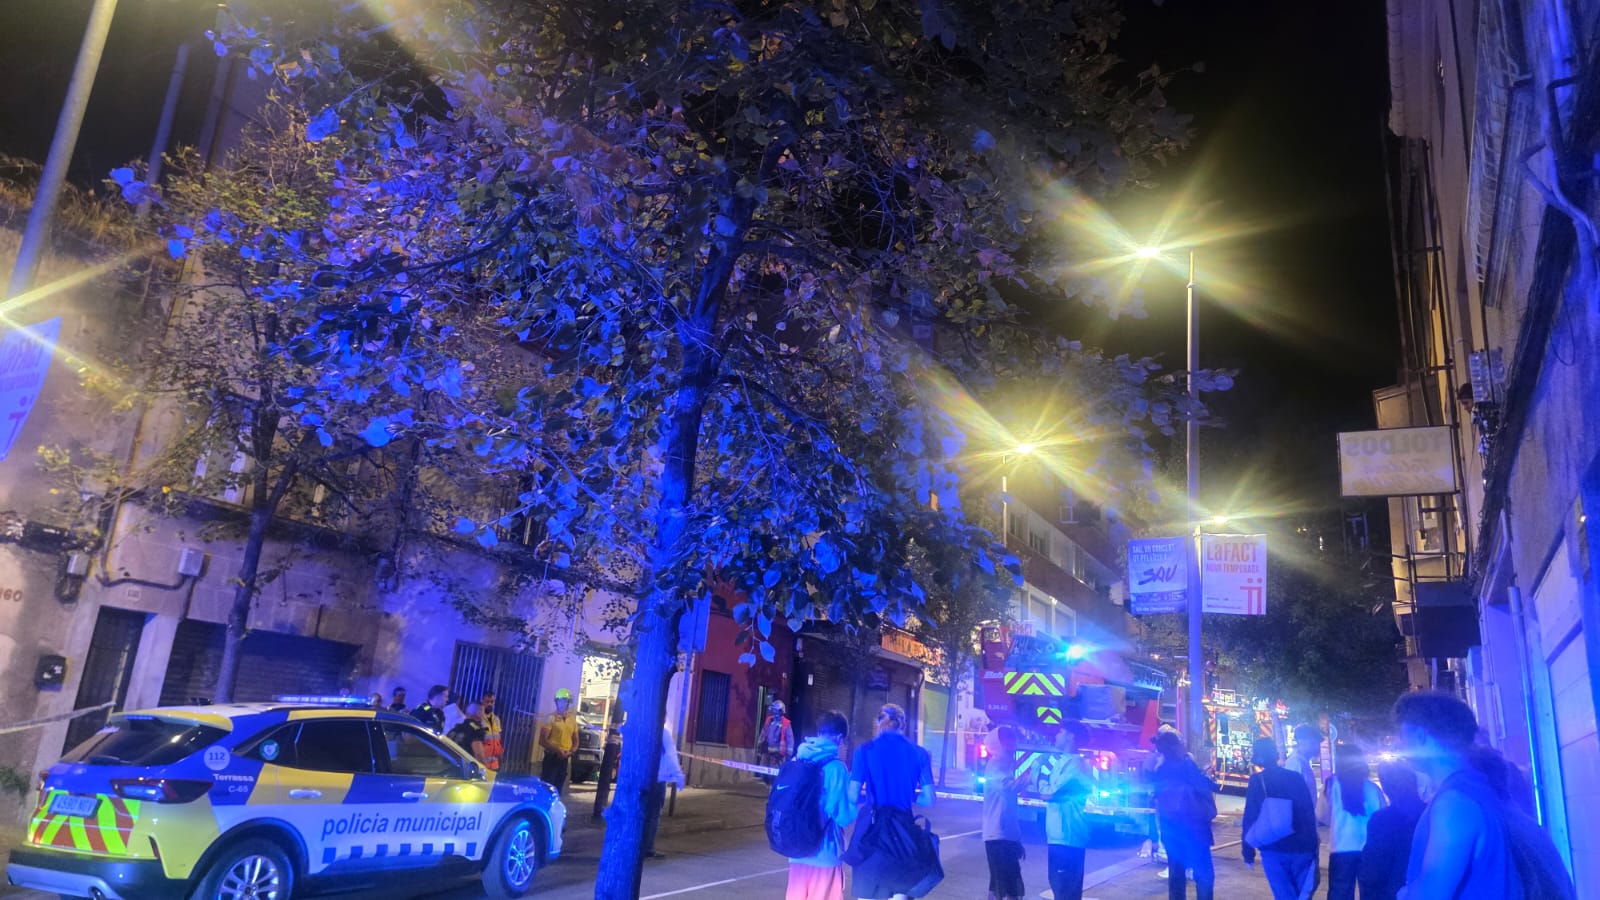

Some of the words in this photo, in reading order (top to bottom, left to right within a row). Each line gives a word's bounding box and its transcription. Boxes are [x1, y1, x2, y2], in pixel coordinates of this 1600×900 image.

[1207, 542, 1257, 561] LaFACT
[208, 751, 225, 762] 112
[212, 773, 254, 783] Terrassa
[321, 812, 389, 842] policia
[393, 811, 482, 836] municipal
